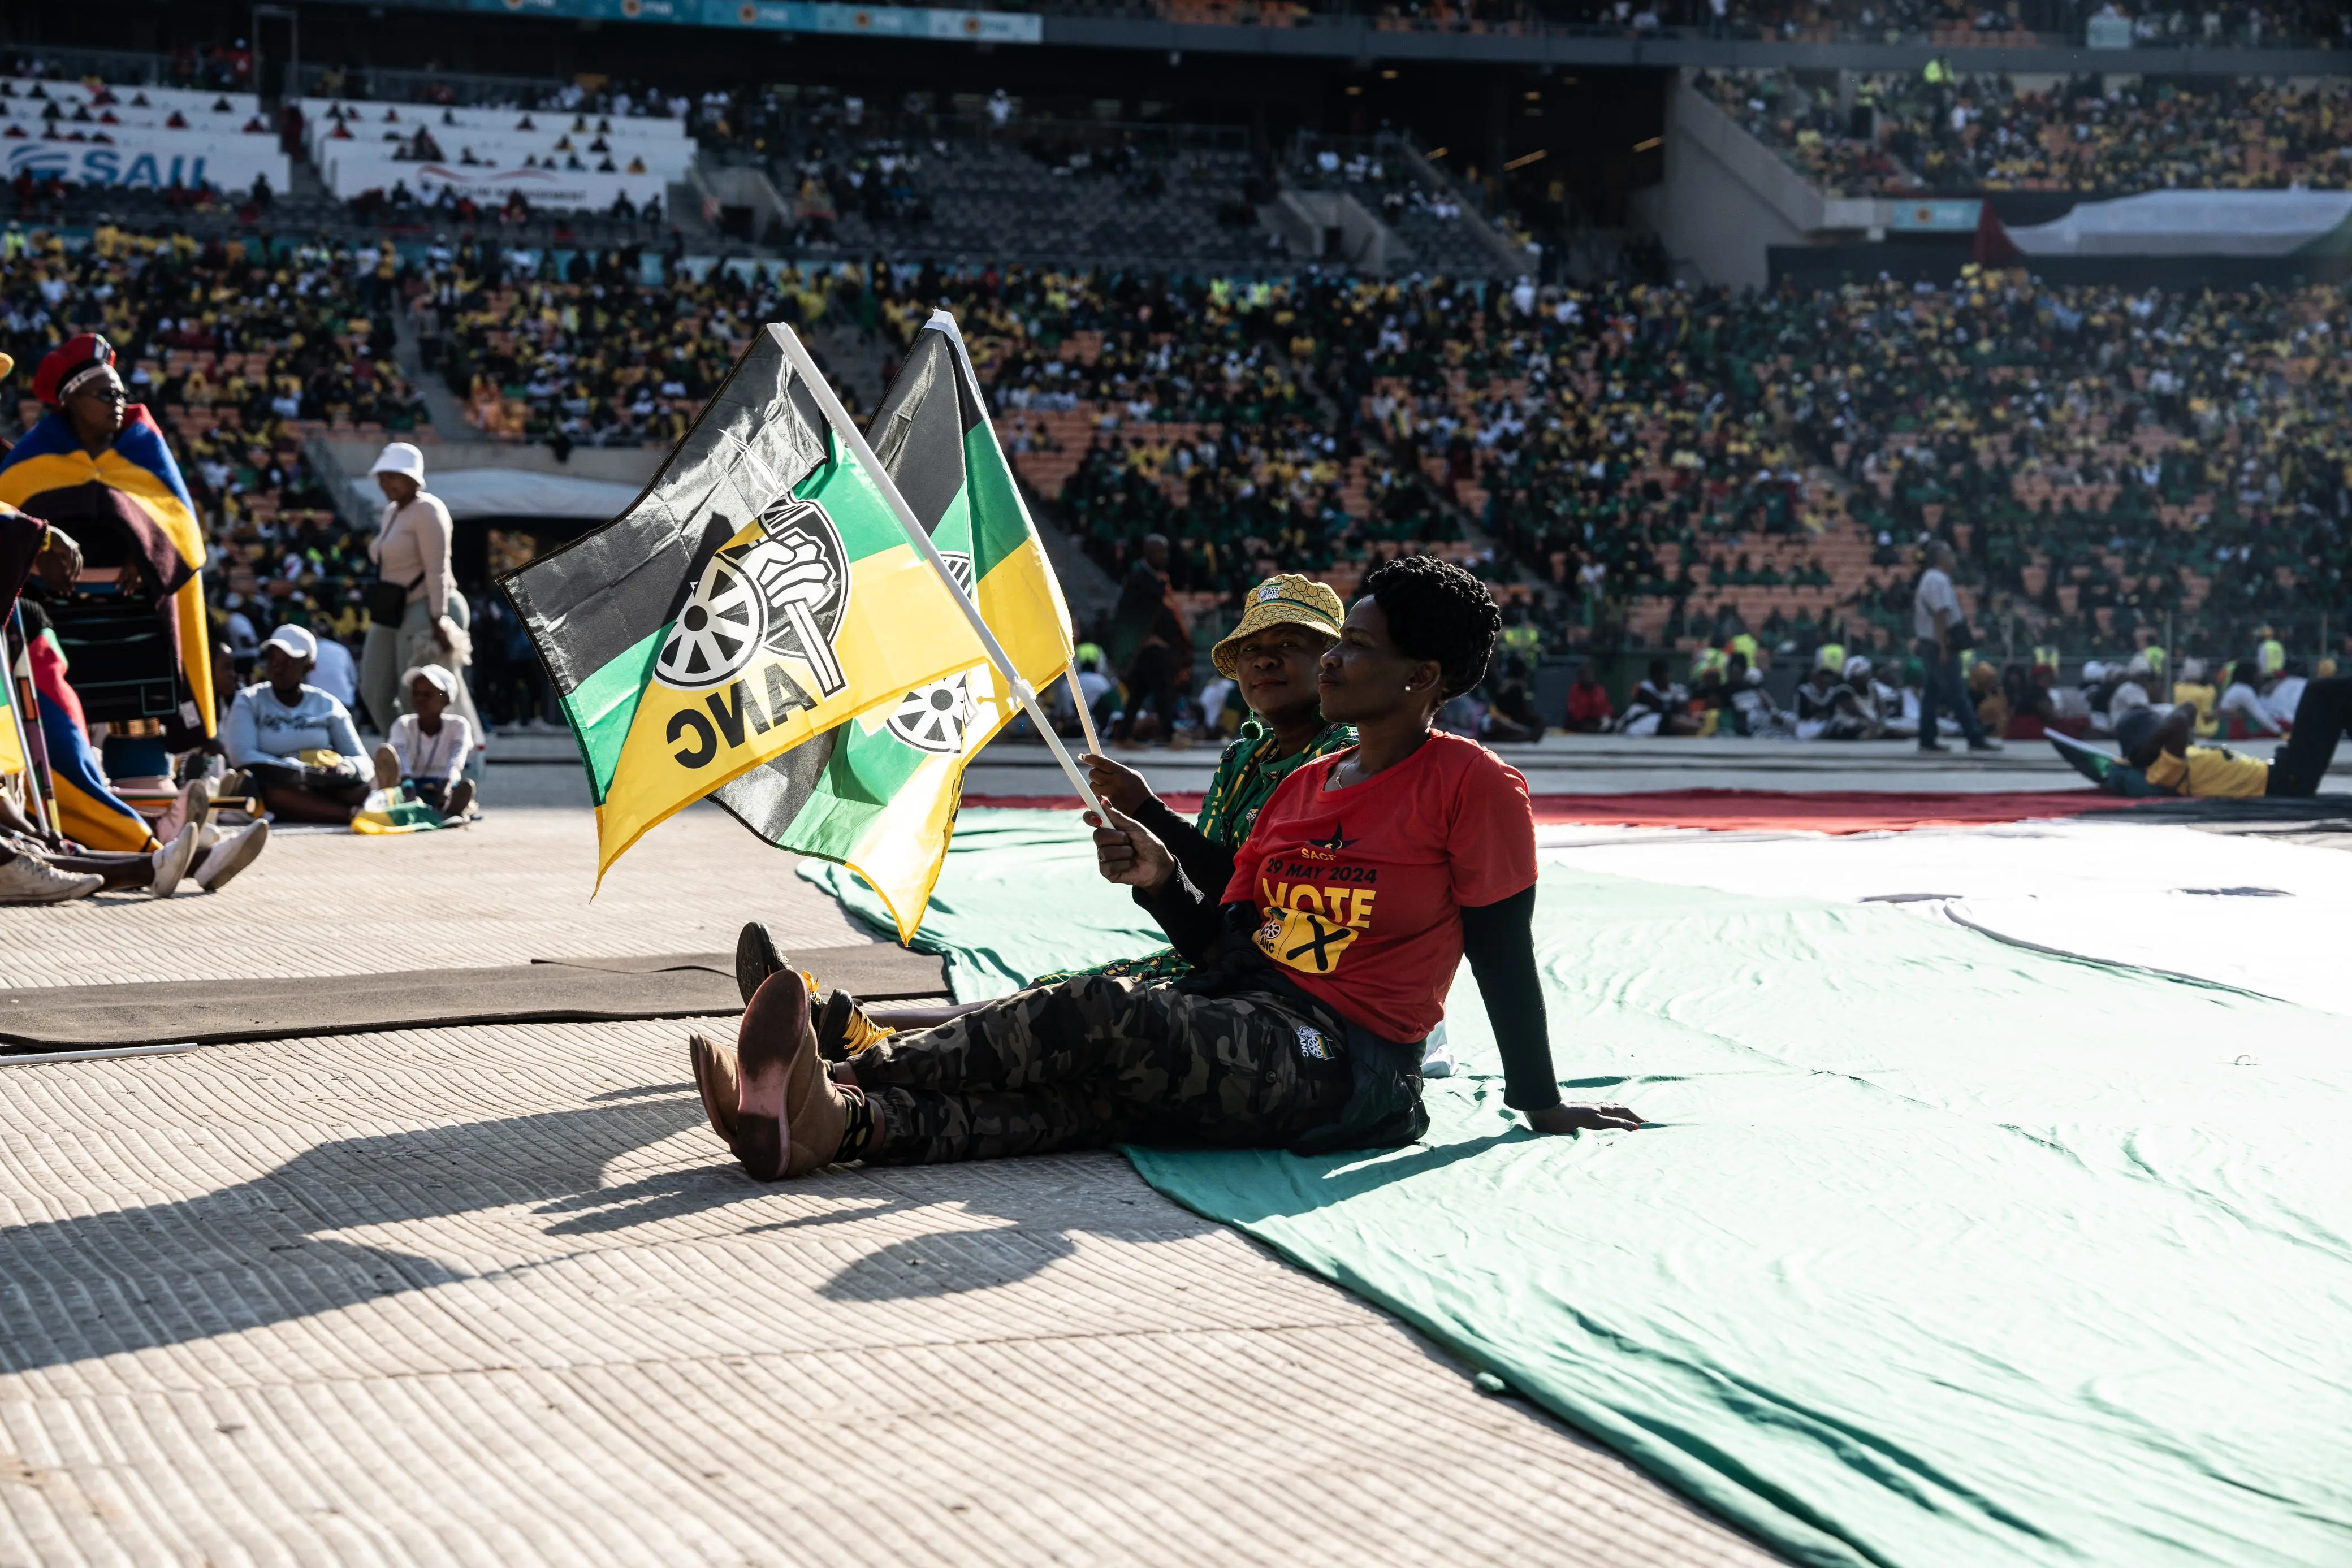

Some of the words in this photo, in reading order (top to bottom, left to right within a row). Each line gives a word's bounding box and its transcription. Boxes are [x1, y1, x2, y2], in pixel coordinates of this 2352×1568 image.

[80, 149, 222, 191] SAIL
[1302, 848, 1337, 860] SACP
[1266, 857, 1283, 874] 29
[1286, 863, 1323, 880] MAY
[1329, 867, 1377, 883] 2024
[1263, 878, 1376, 929] VOTE
[1260, 936, 1275, 954] ANC
[1300, 1037, 1309, 1057] ANC
